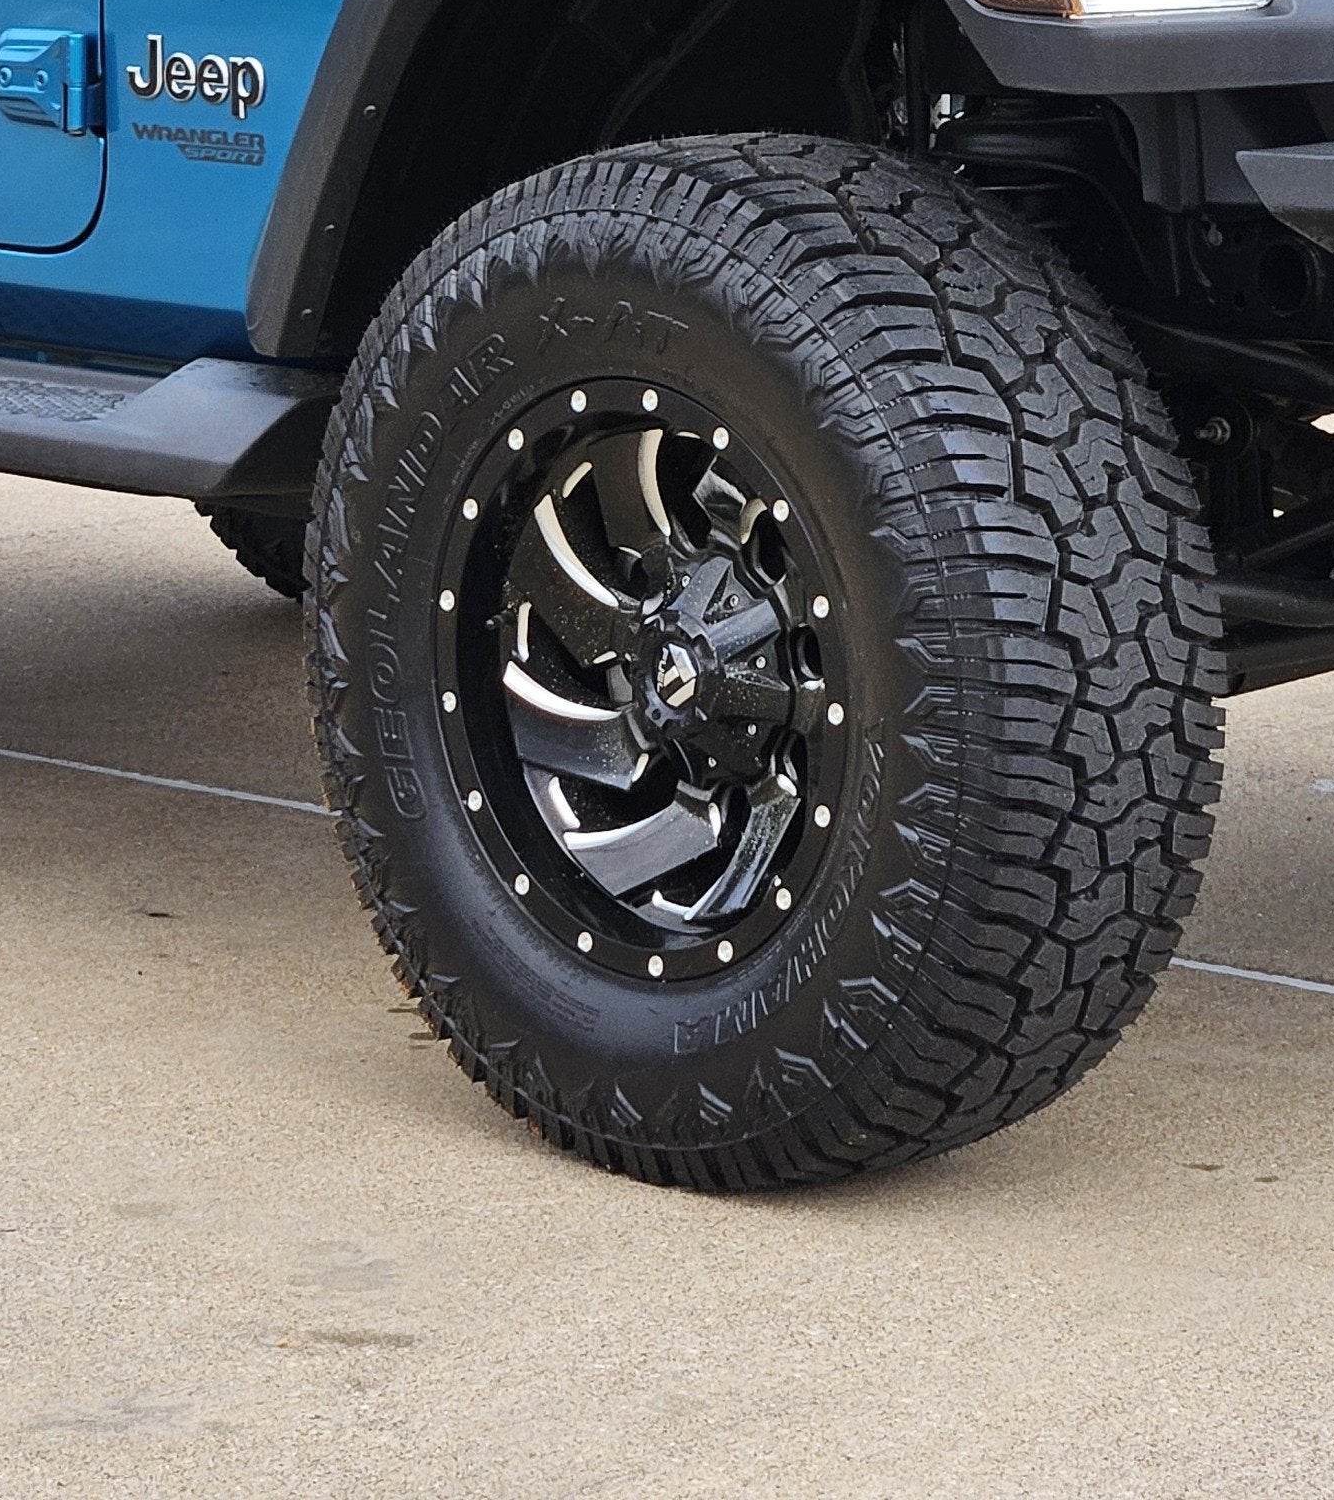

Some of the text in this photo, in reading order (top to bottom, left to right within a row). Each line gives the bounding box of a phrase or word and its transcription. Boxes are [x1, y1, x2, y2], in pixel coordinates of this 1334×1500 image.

[126, 33, 266, 120] Jeep
[132, 122, 265, 148] WRANGLER
[184, 146, 262, 164] SPORT
